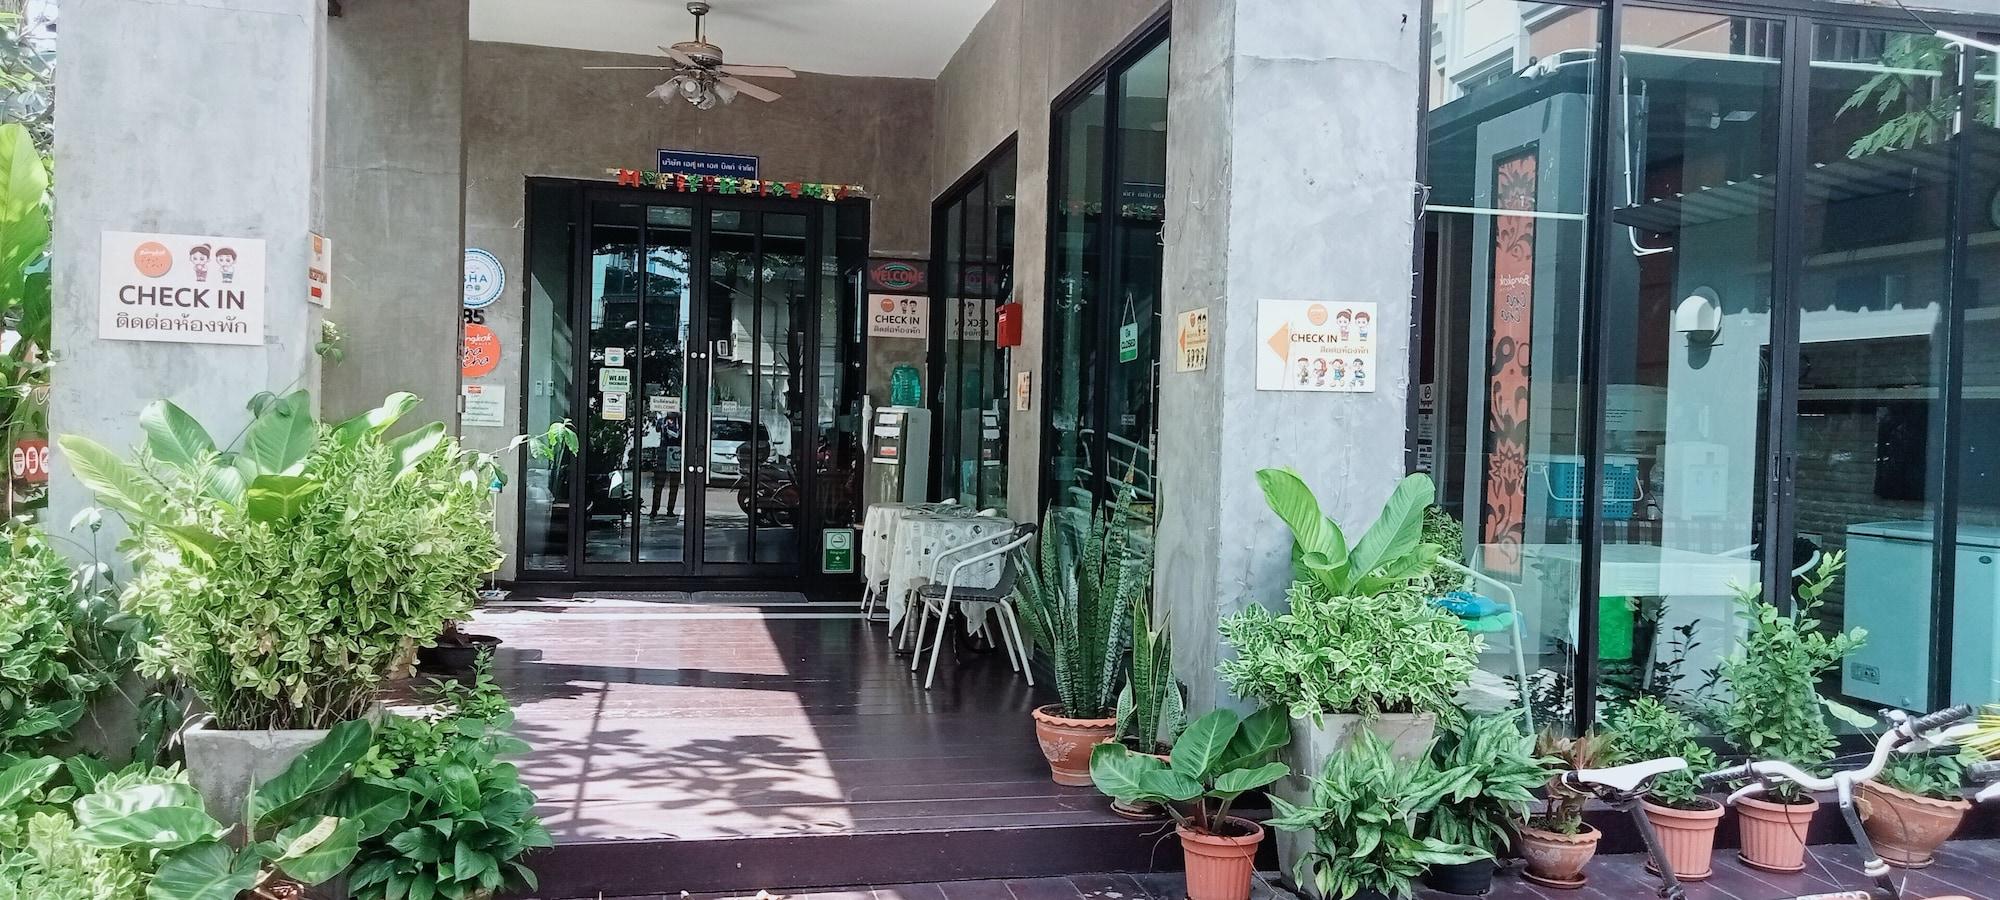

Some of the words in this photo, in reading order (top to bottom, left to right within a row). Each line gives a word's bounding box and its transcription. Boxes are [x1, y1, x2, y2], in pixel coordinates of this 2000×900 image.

[464, 274, 488, 283] HA
[870, 269, 925, 283] WELCOME
[119, 284, 210, 309] CHECK
[218, 289, 245, 310] IN
[116, 312, 247, 334] ติดต่อห้องพัก
[875, 314, 908, 325] CHECK
[909, 316, 920, 325] IN
[1290, 333, 1325, 343] CHECK
[1327, 334, 1338, 343] IN
